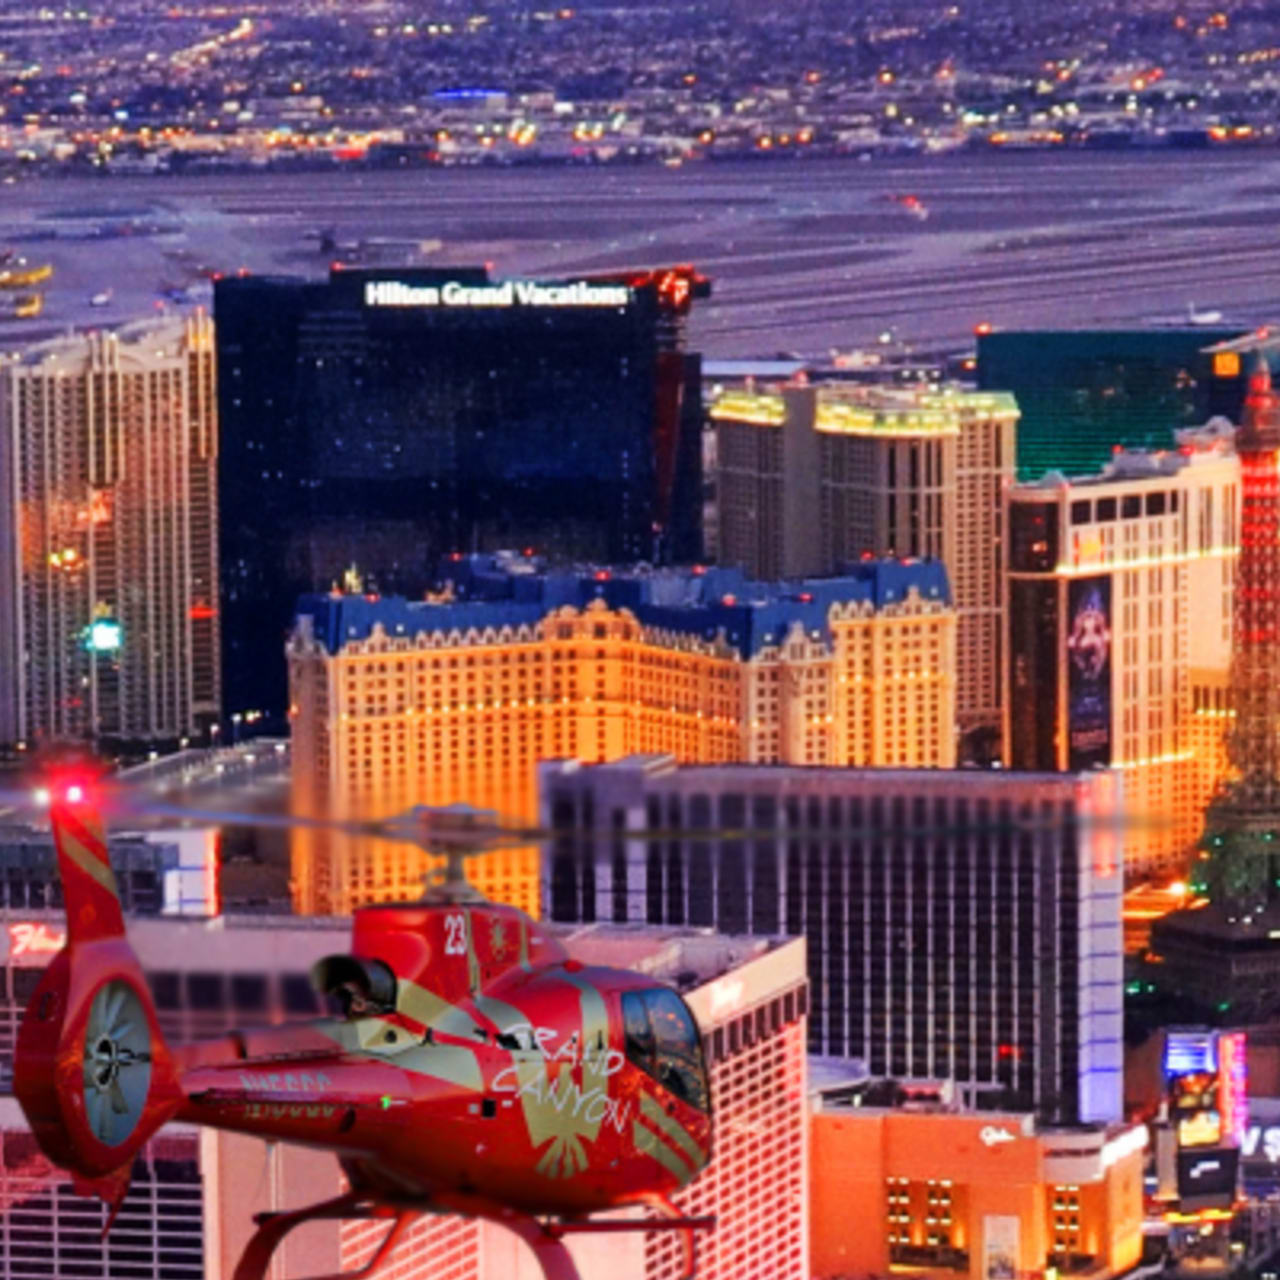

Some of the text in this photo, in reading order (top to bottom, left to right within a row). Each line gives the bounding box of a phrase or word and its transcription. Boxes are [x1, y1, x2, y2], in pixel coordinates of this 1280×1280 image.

[365, 281, 628, 306] Hilton Grand Vacations
[444, 913, 467, 955] 23
[497, 1022, 626, 1077] GRAND
[491, 1064, 631, 1134] CANYON
